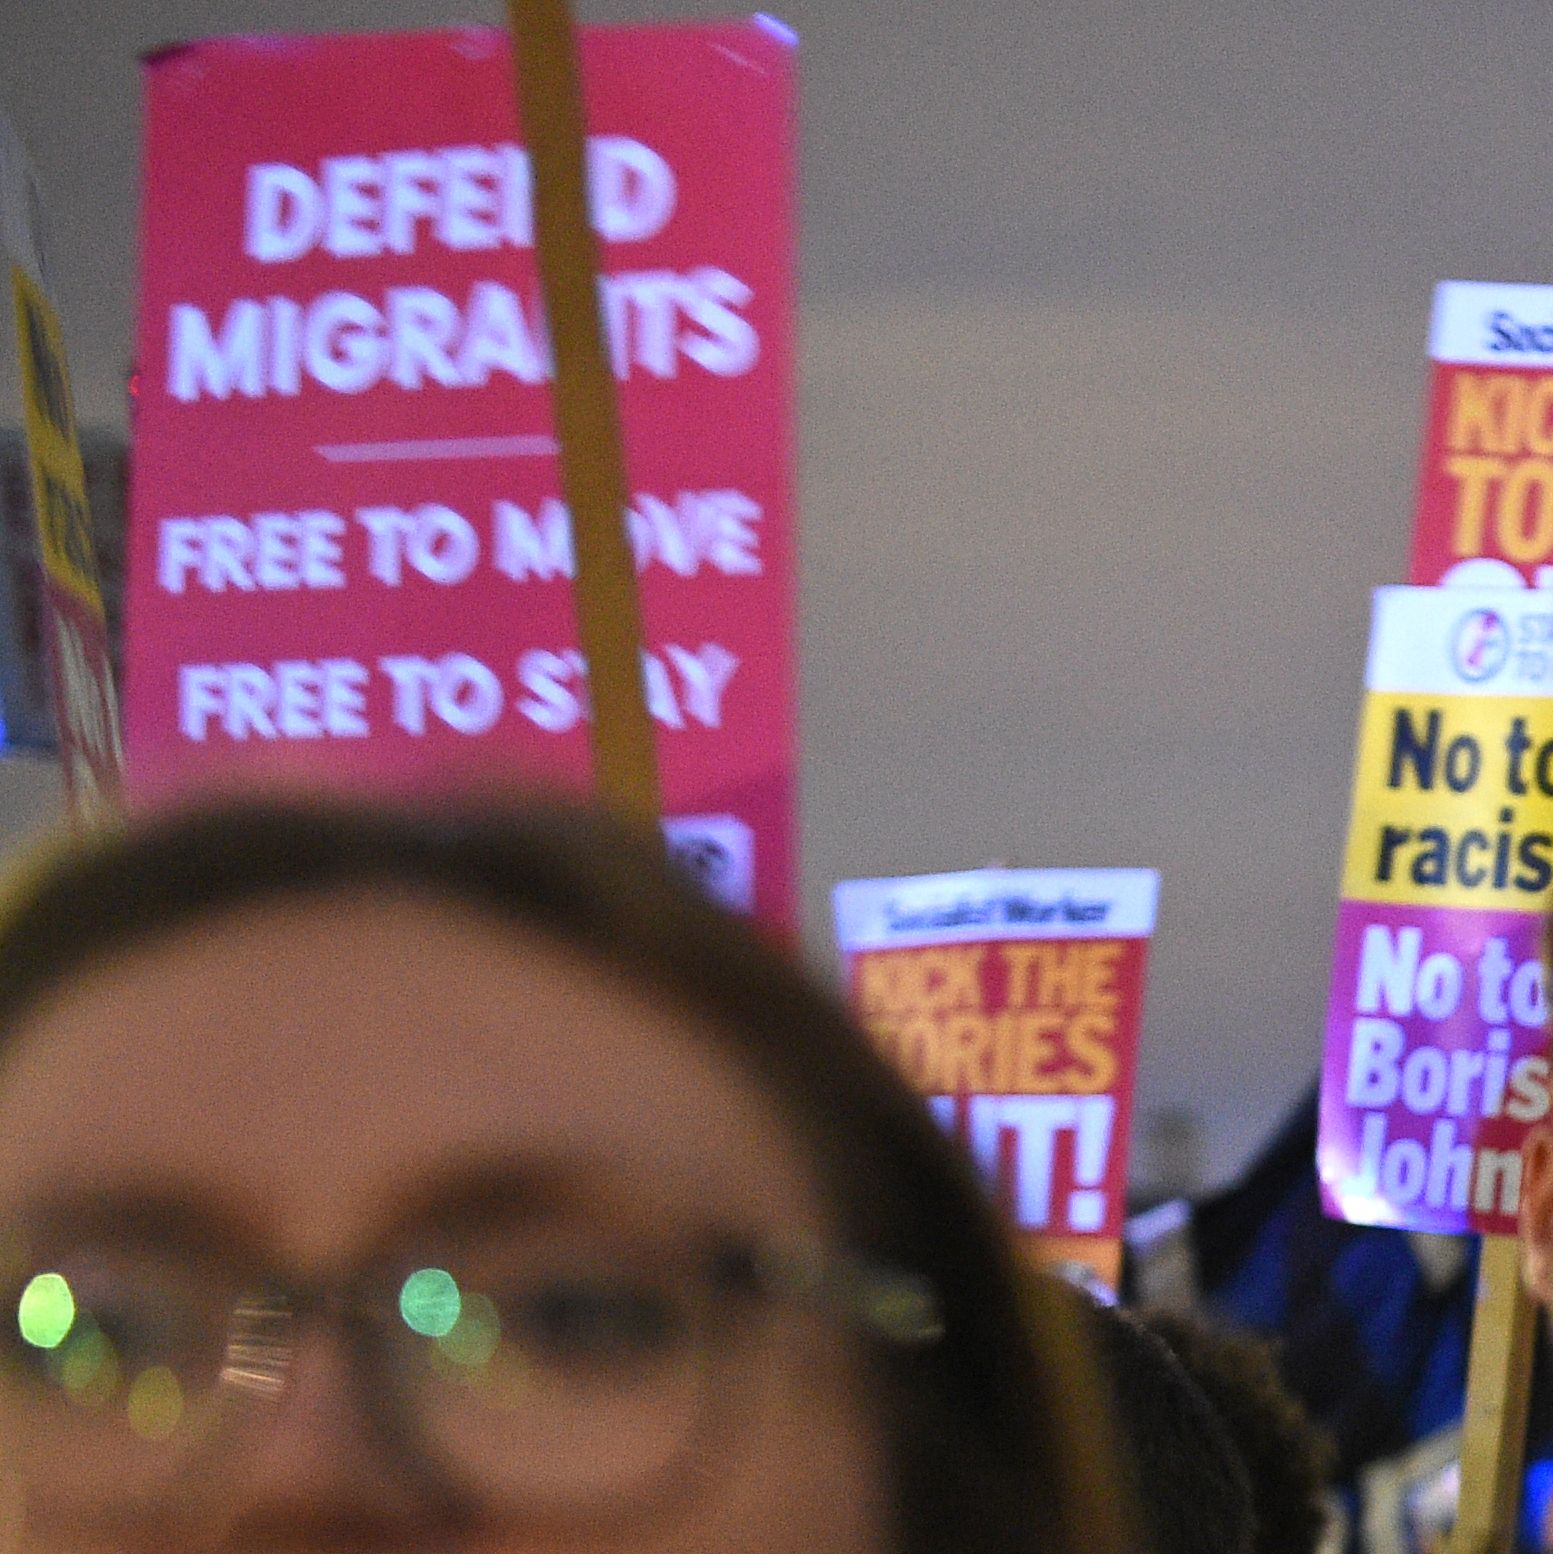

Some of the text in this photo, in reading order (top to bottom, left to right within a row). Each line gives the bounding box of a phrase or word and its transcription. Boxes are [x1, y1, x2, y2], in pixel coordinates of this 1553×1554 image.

[245, 133, 678, 265] DEFED
[158, 508, 348, 595] FREE
[355, 504, 481, 586] TO
[179, 656, 370, 743] FREE
[379, 650, 506, 737] TO
[515, 641, 742, 735] SAY
[1387, 705, 1482, 794] No
[1004, 941, 1122, 1011] THE
[1356, 922, 1465, 1020] No
[1346, 1014, 1553, 1124] Boris
